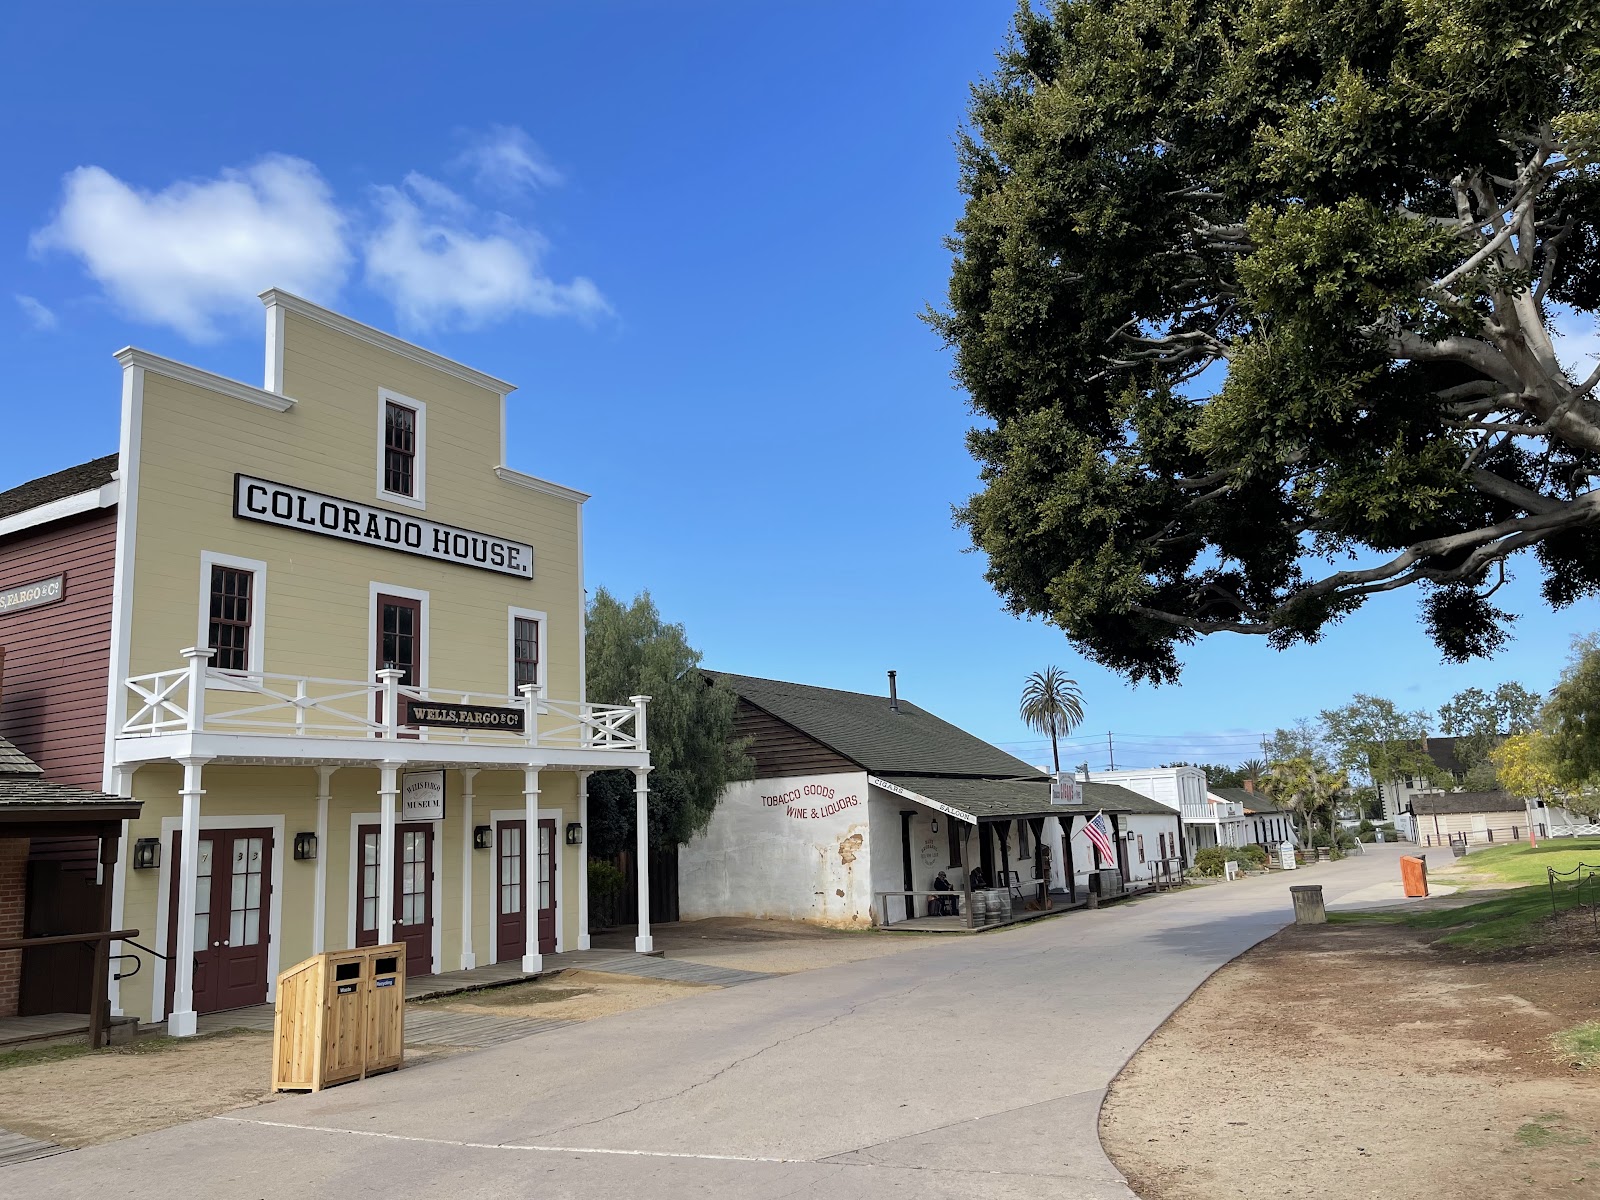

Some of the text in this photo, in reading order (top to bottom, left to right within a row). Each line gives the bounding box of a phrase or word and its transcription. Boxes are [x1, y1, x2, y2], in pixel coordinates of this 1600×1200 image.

[247, 484, 527, 571] COLORADO HOUSE.
[7, 587, 40, 606] FARGO
[413, 707, 458, 723] WELLS,
[459, 711, 499, 724] FARGO
[407, 799, 440, 809] MUSEUM
[761, 784, 835, 807] TOBACCO GOODS
[786, 794, 862, 819] WINE & LIQUORS.
[874, 779, 970, 820] CIGARS SALOON
